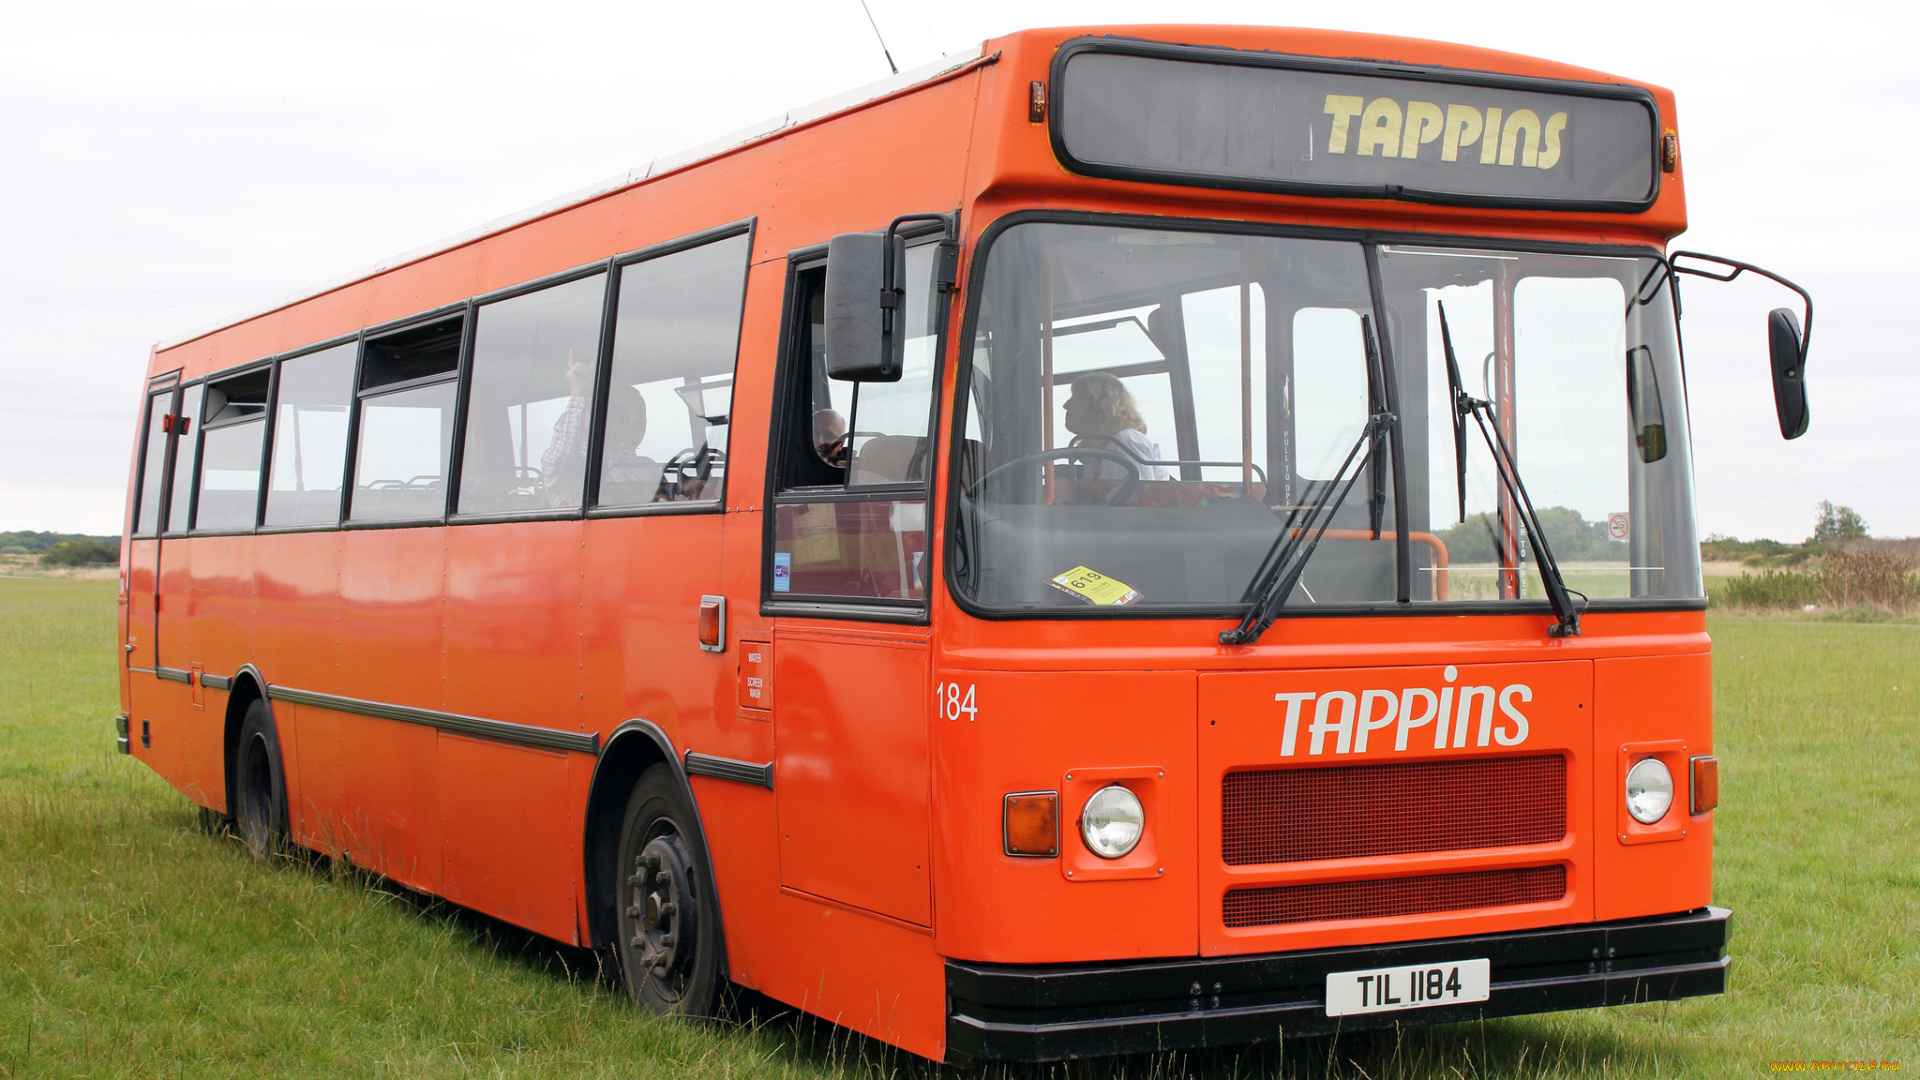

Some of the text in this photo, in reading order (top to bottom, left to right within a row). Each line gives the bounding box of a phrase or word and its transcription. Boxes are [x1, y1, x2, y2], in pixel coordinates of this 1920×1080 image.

[1322, 94, 1568, 170] TAPPINS
[1285, 465, 1290, 481] TO
[1070, 572, 1102, 589] 619
[747, 652, 762, 664] WATER
[747, 676, 763, 688] SCREEN
[749, 688, 761, 699] WASH
[936, 681, 978, 722] 184
[1356, 966, 1462, 1008] TIL 1184
